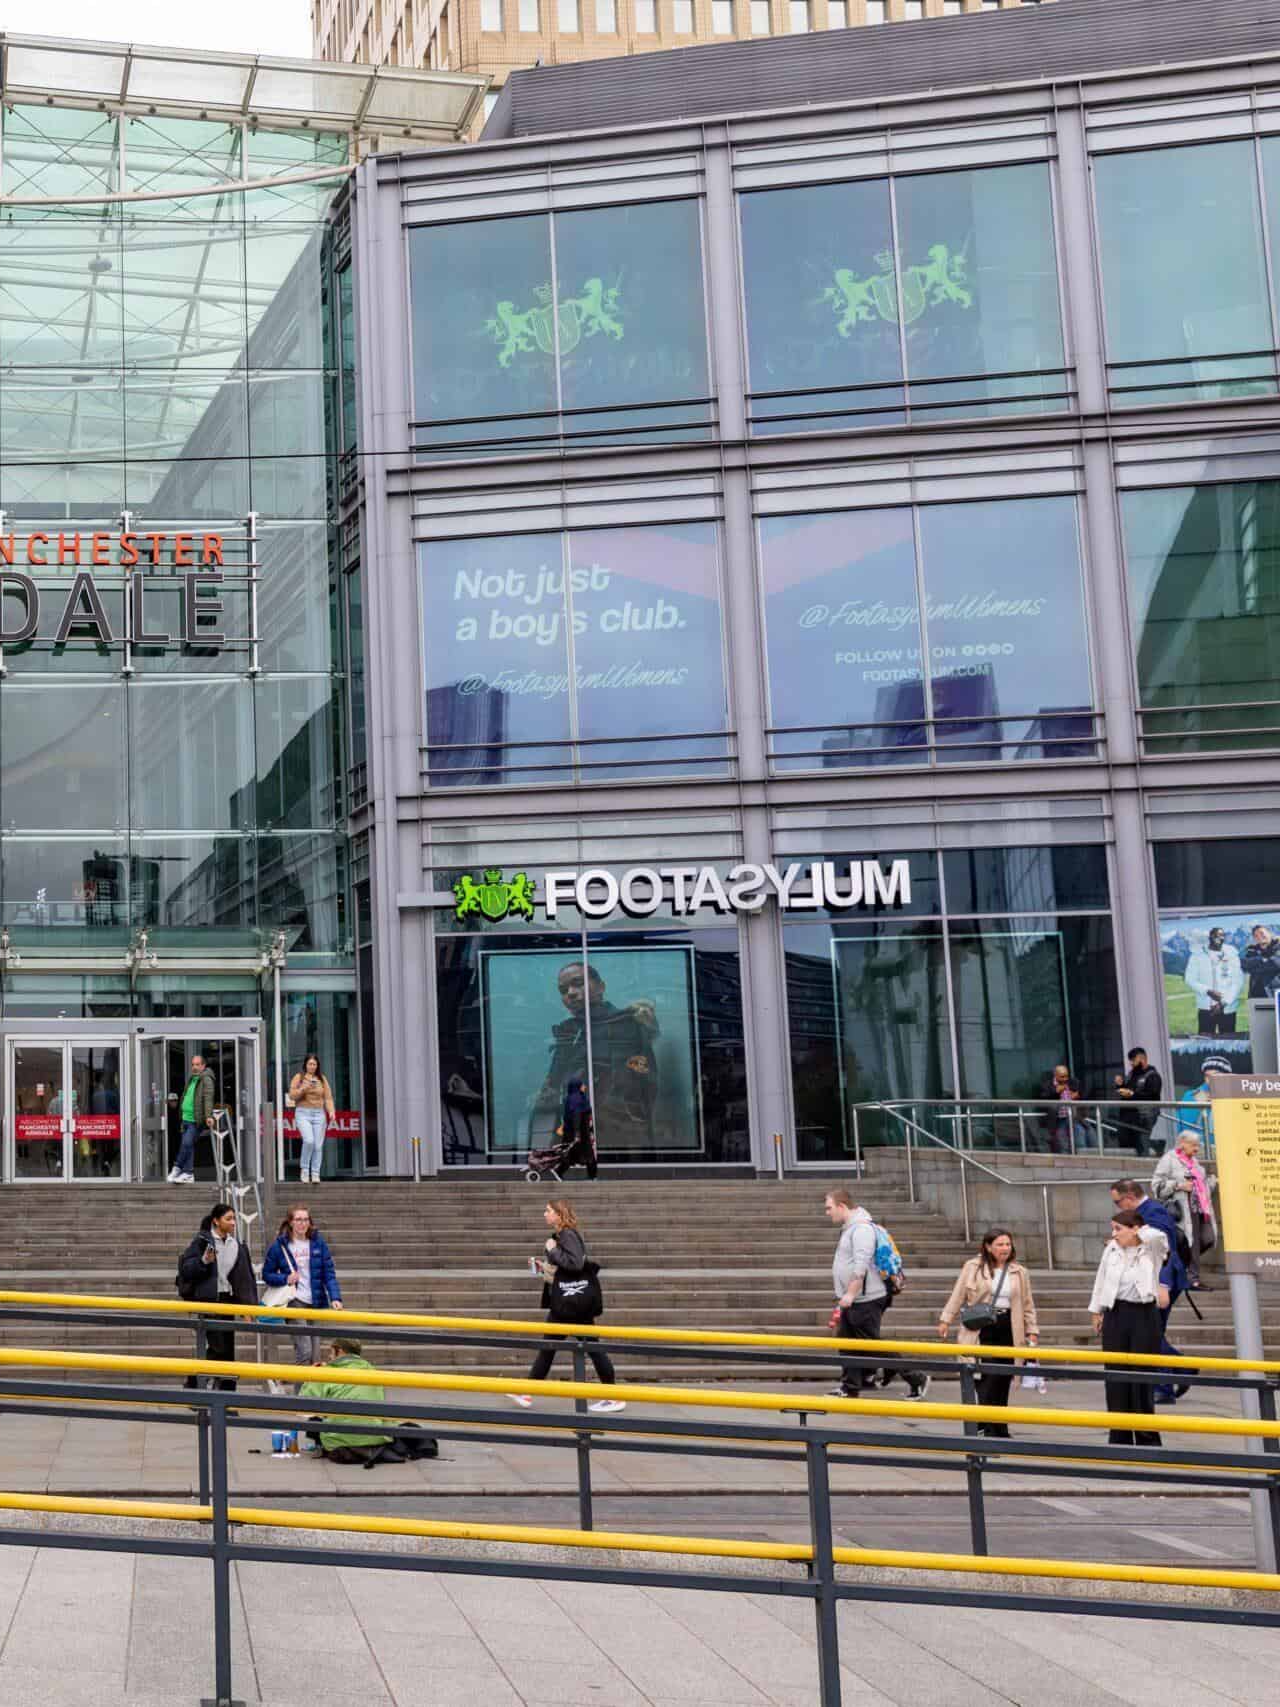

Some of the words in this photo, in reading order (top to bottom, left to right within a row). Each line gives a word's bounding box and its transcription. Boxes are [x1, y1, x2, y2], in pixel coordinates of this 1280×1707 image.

[454, 568, 526, 600] Not
[523, 562, 610, 605] just
[456, 616, 477, 641] a
[488, 607, 589, 646] boy's
[600, 599, 687, 633] club.
[835, 649, 902, 664] FOLLOW
[907, 647, 926, 660] U
[932, 647, 956, 658] ON
[544, 859, 912, 916] FOOTASYLUM
[1241, 1079, 1262, 1094] Pay
